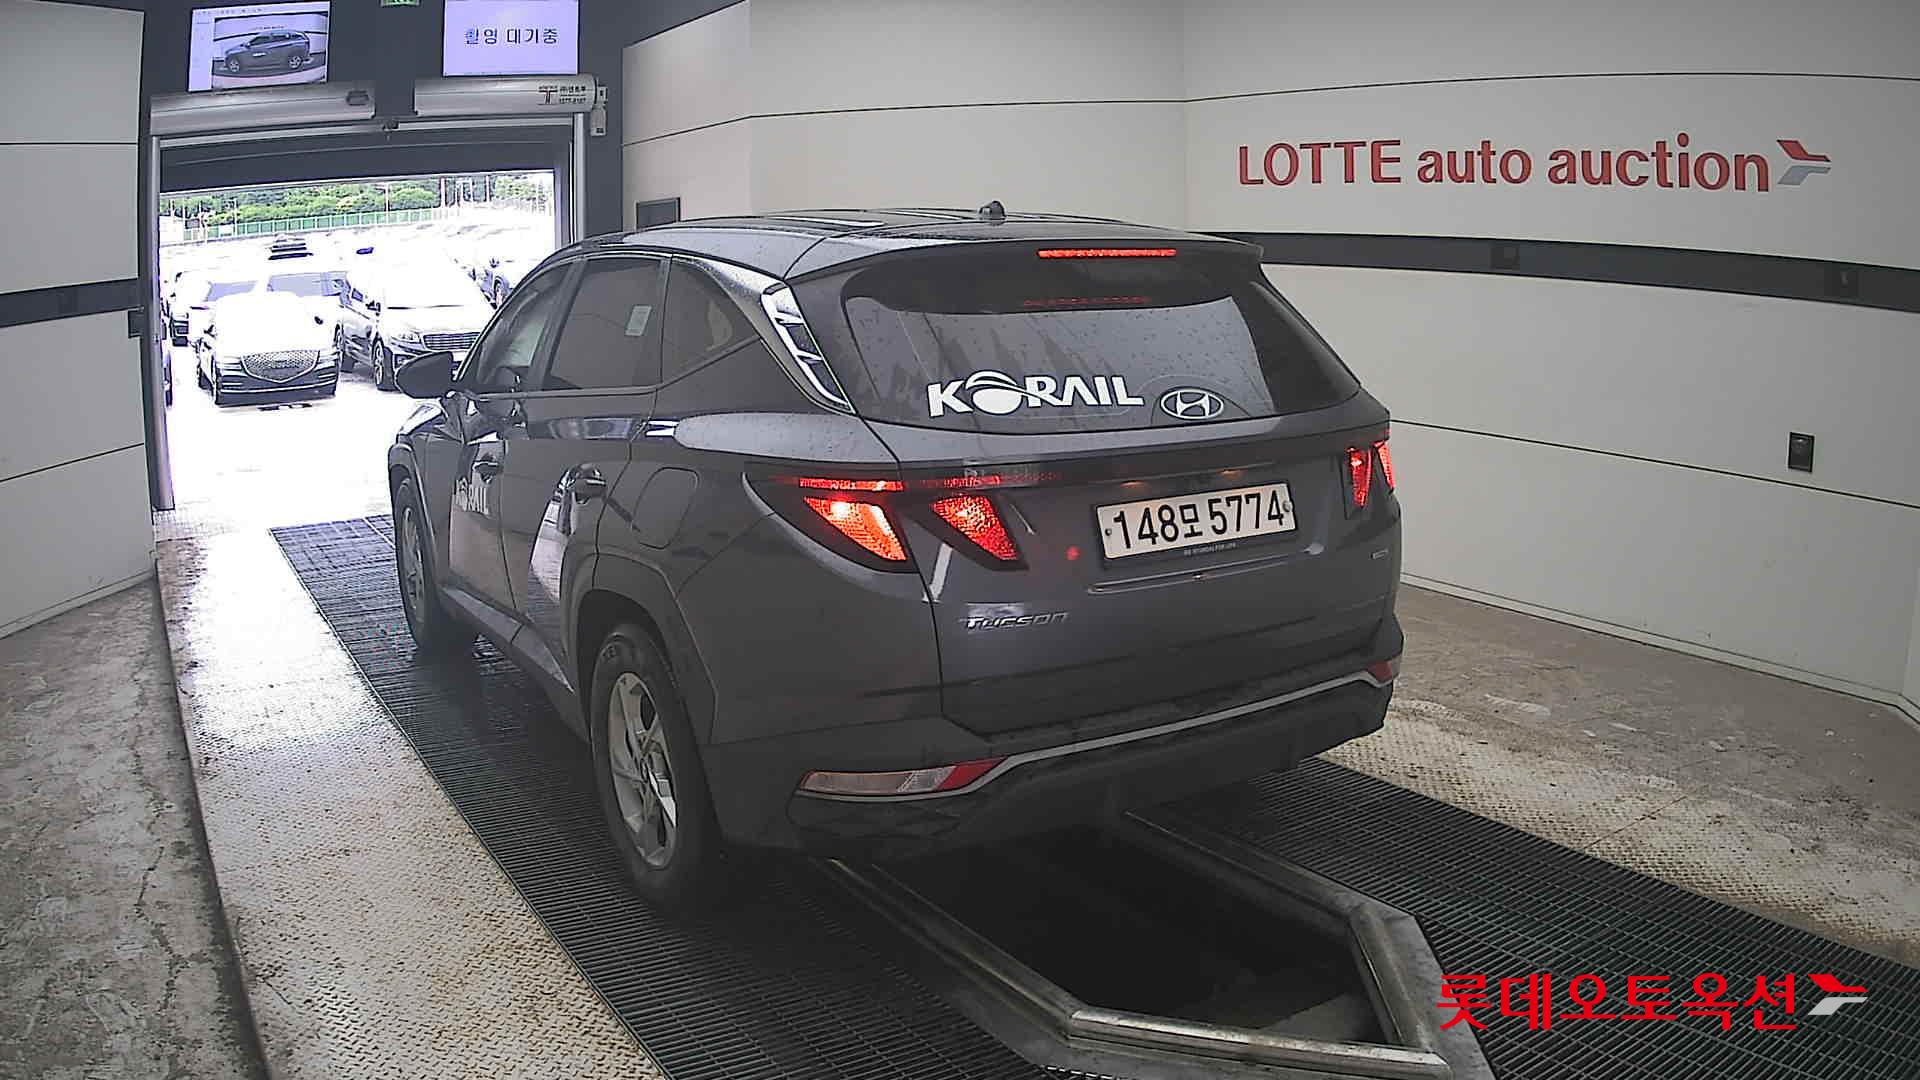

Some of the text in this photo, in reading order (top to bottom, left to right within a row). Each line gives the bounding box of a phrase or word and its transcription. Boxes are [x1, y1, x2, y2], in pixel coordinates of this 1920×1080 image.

[506, 28, 559, 44] 대기중
[1238, 131, 1771, 193] LOTTE auto auction
[926, 369, 1145, 418] KORAIL
[1113, 490, 1285, 550] 148모 5774
